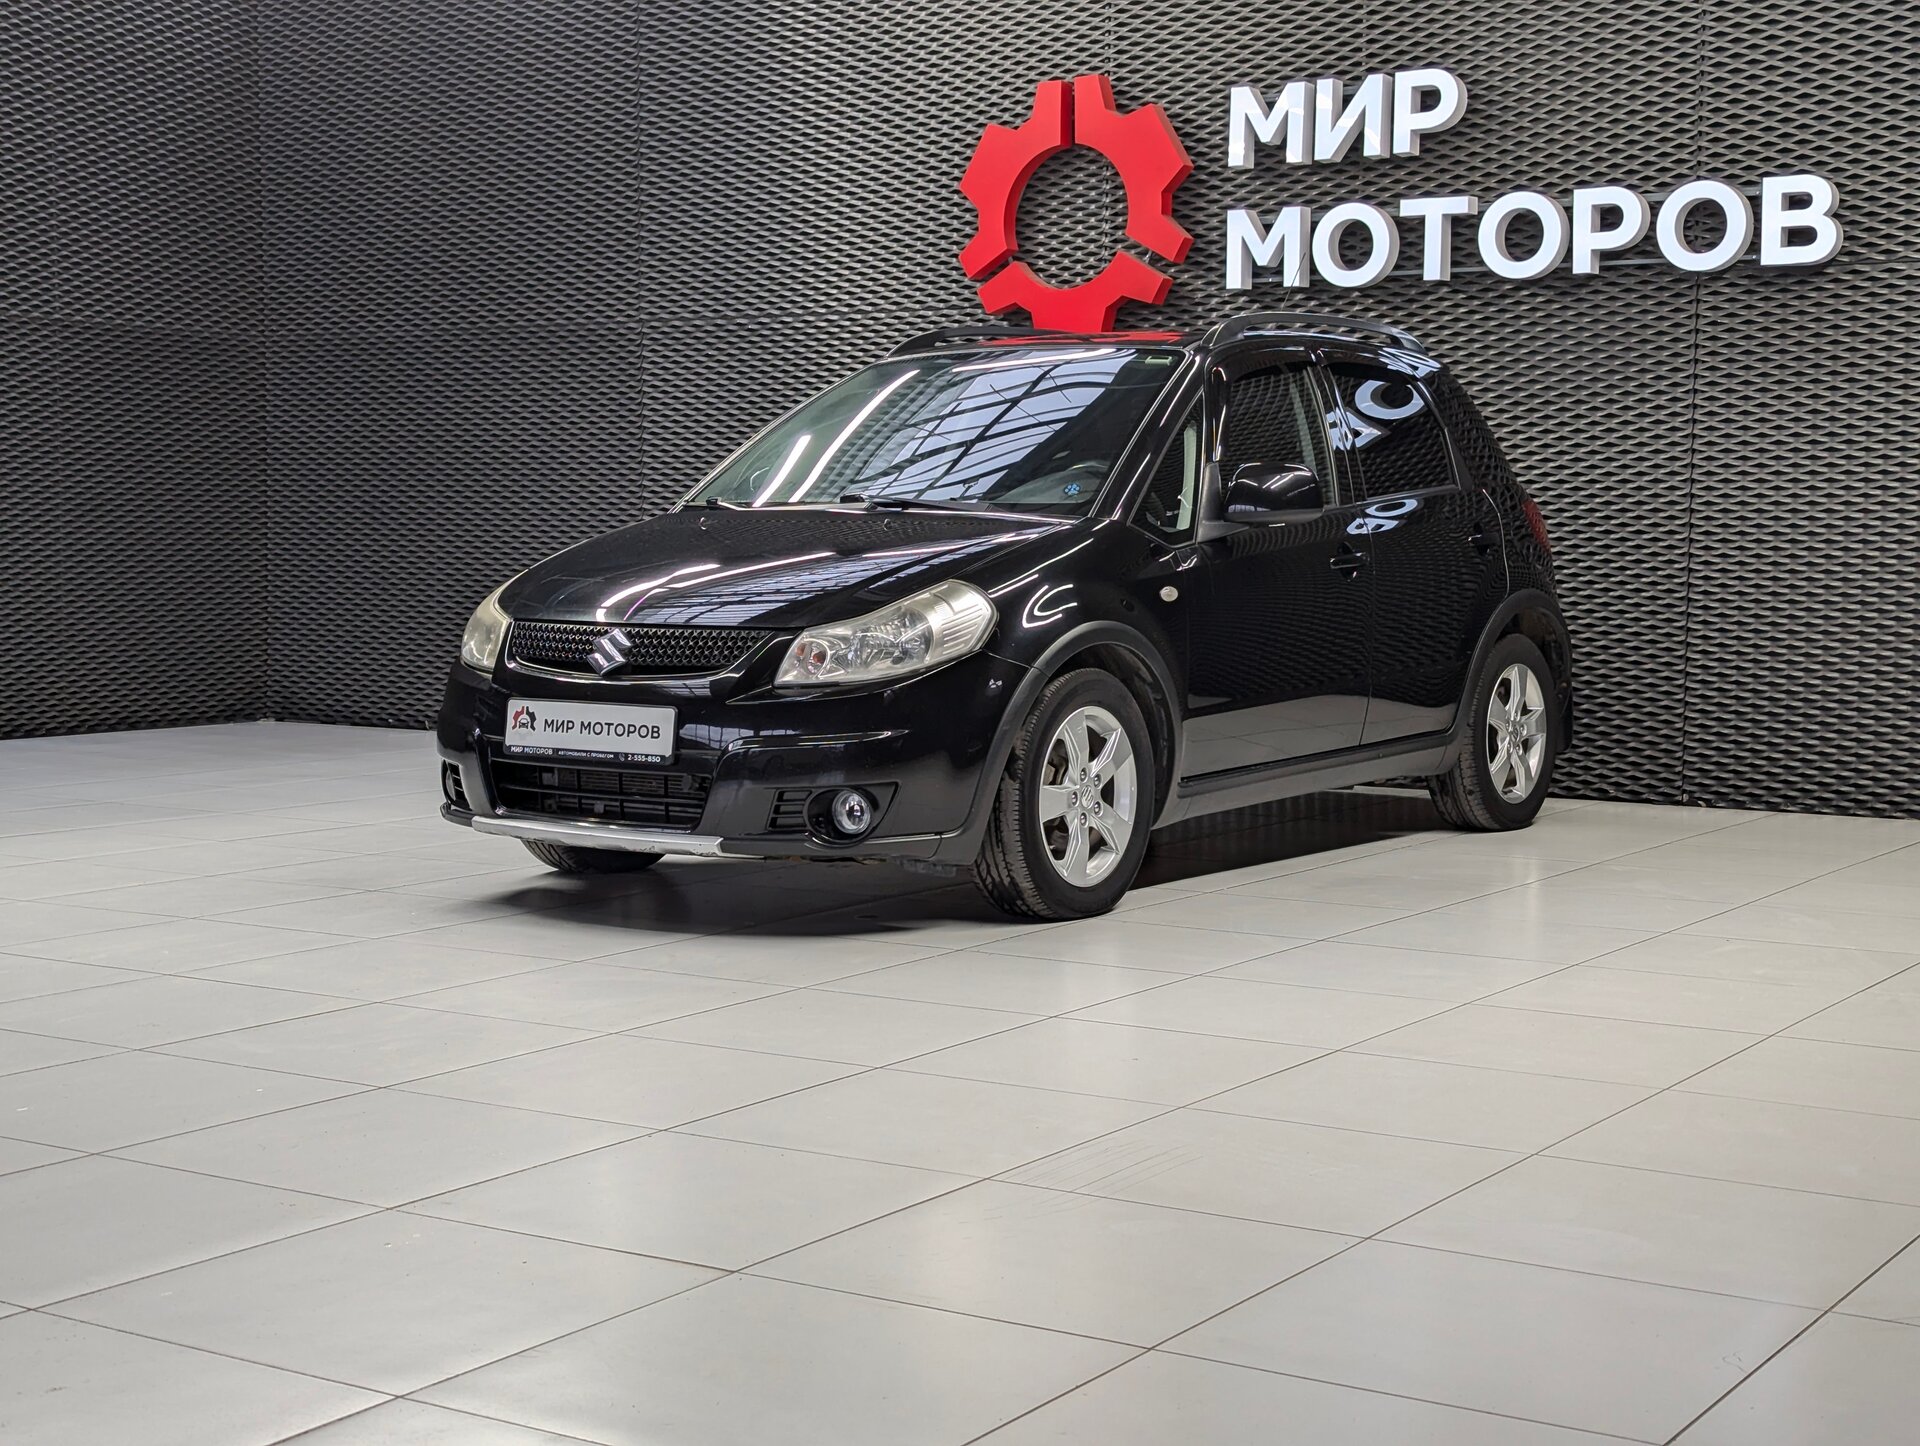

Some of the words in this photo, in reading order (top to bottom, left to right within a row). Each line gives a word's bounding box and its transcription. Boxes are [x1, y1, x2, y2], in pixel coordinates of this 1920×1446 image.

[1227, 68, 1467, 169] МИР
[1225, 174, 1842, 290] МОТОРОВ
[543, 718, 575, 733] МИР
[580, 721, 661, 739] МОТОРОВ
[524, 747, 553, 755] МОТОРОВ
[627, 754, 661, 763] 2-555-850
